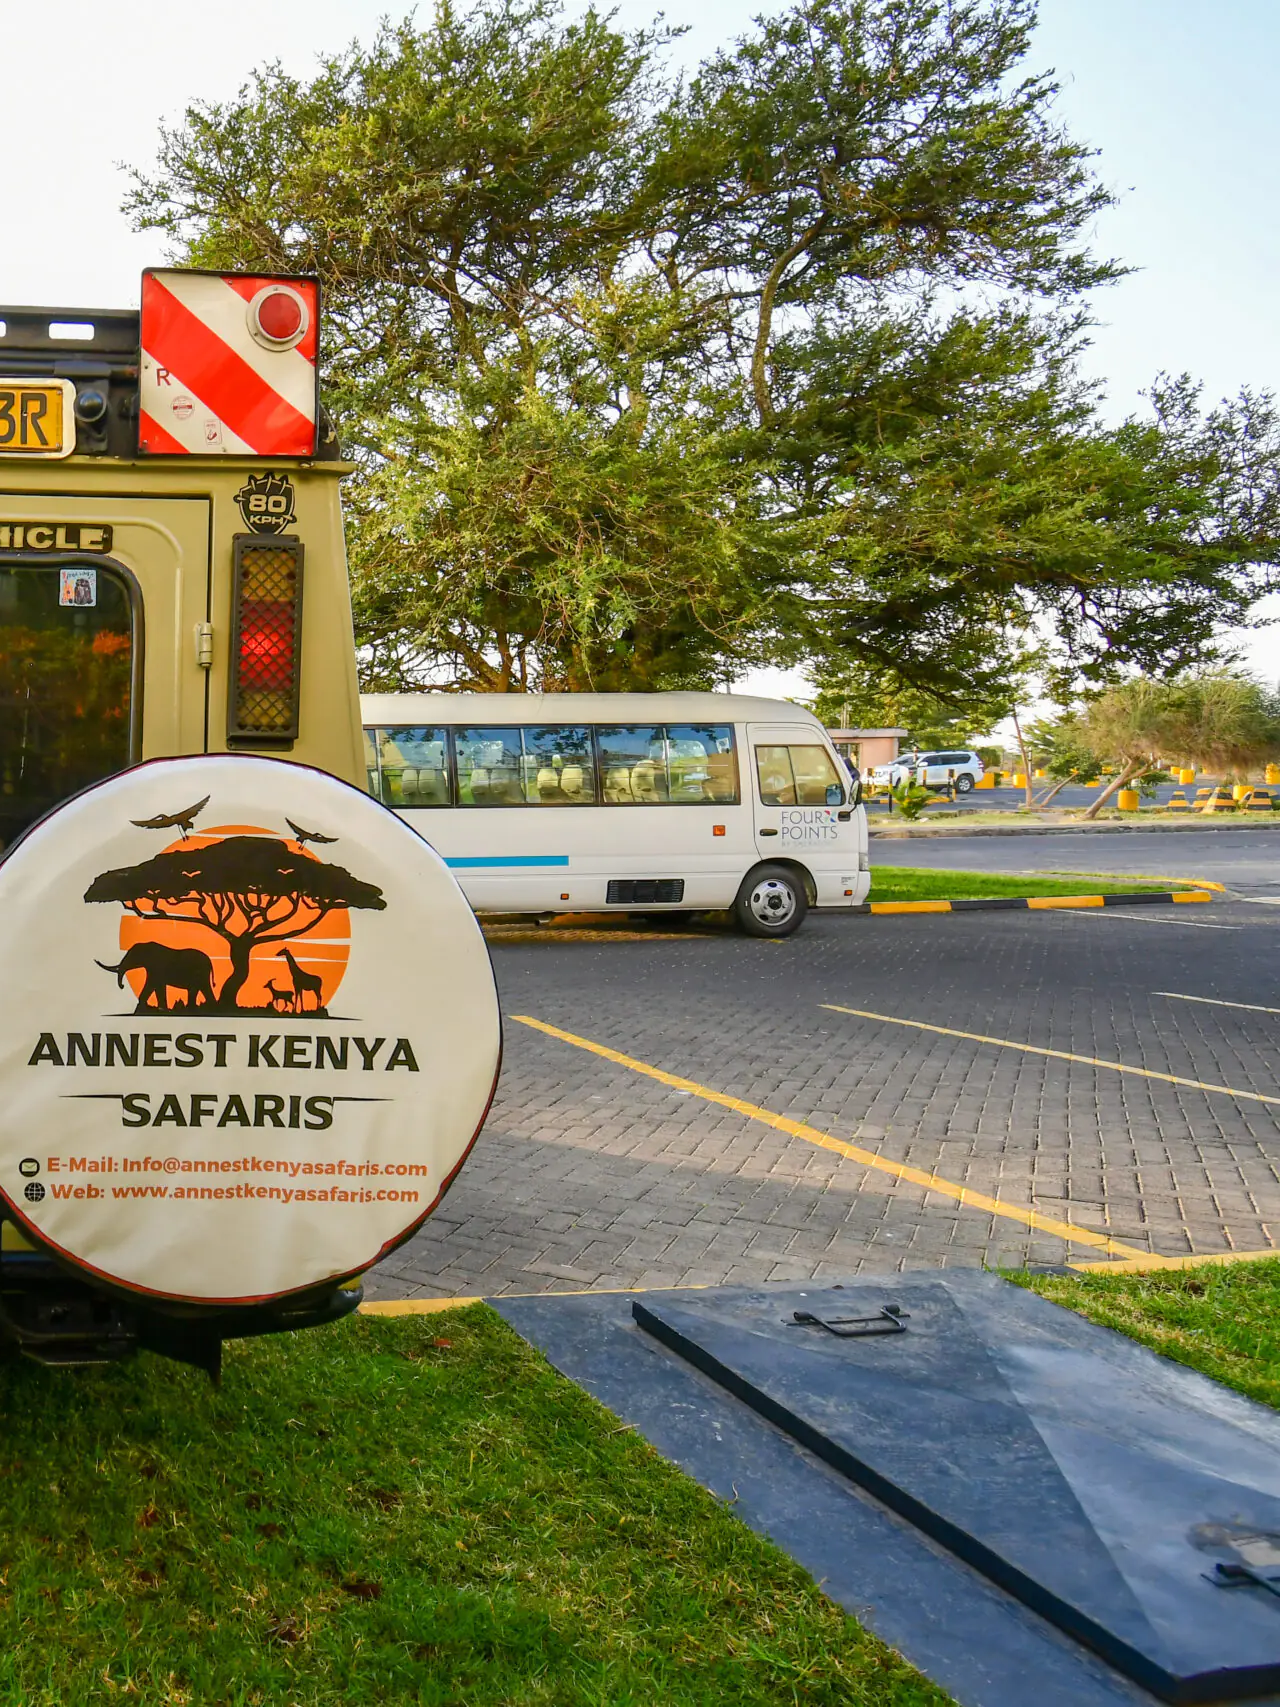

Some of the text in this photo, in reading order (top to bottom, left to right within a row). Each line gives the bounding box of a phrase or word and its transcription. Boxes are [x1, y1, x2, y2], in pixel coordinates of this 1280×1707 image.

[156, 368, 171, 387] R
[248, 494, 287, 513] 80
[249, 515, 284, 526] KPH
[781, 811, 824, 824] FOUR
[781, 826, 838, 839] POINTS
[27, 1032, 420, 1072] ANNEST KENYA
[121, 1093, 335, 1130] SAFARIS
[47, 1156, 428, 1177] E-Mail: Info@annestkenyasafaris.com
[50, 1183, 419, 1204] Web: www.annestkenyasafaris.com
